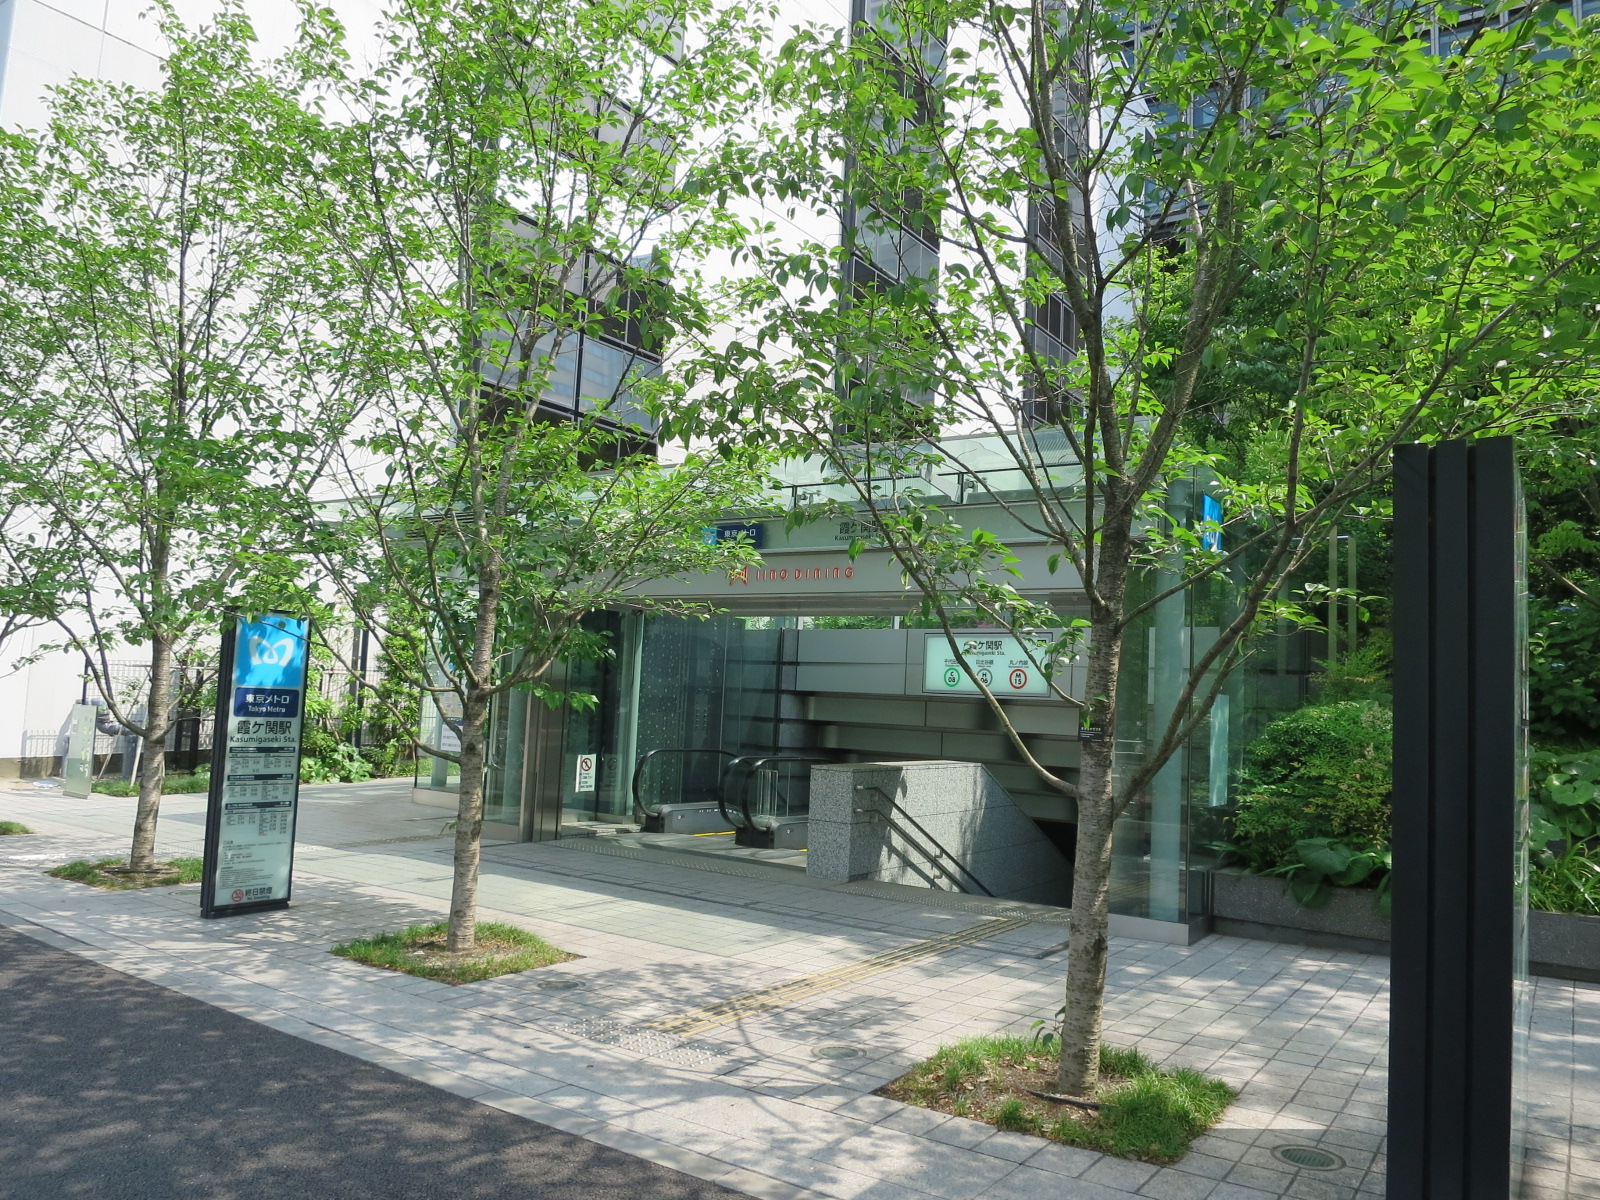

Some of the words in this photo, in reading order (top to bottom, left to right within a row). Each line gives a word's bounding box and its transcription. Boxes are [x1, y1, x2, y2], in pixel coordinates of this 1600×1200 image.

[245, 693, 290, 704] 東京メトロ
[248, 705, 267, 714] Tokyo
[229, 735, 282, 744] Kasumigaseki
[245, 887, 273, 896] 終日禁煙
